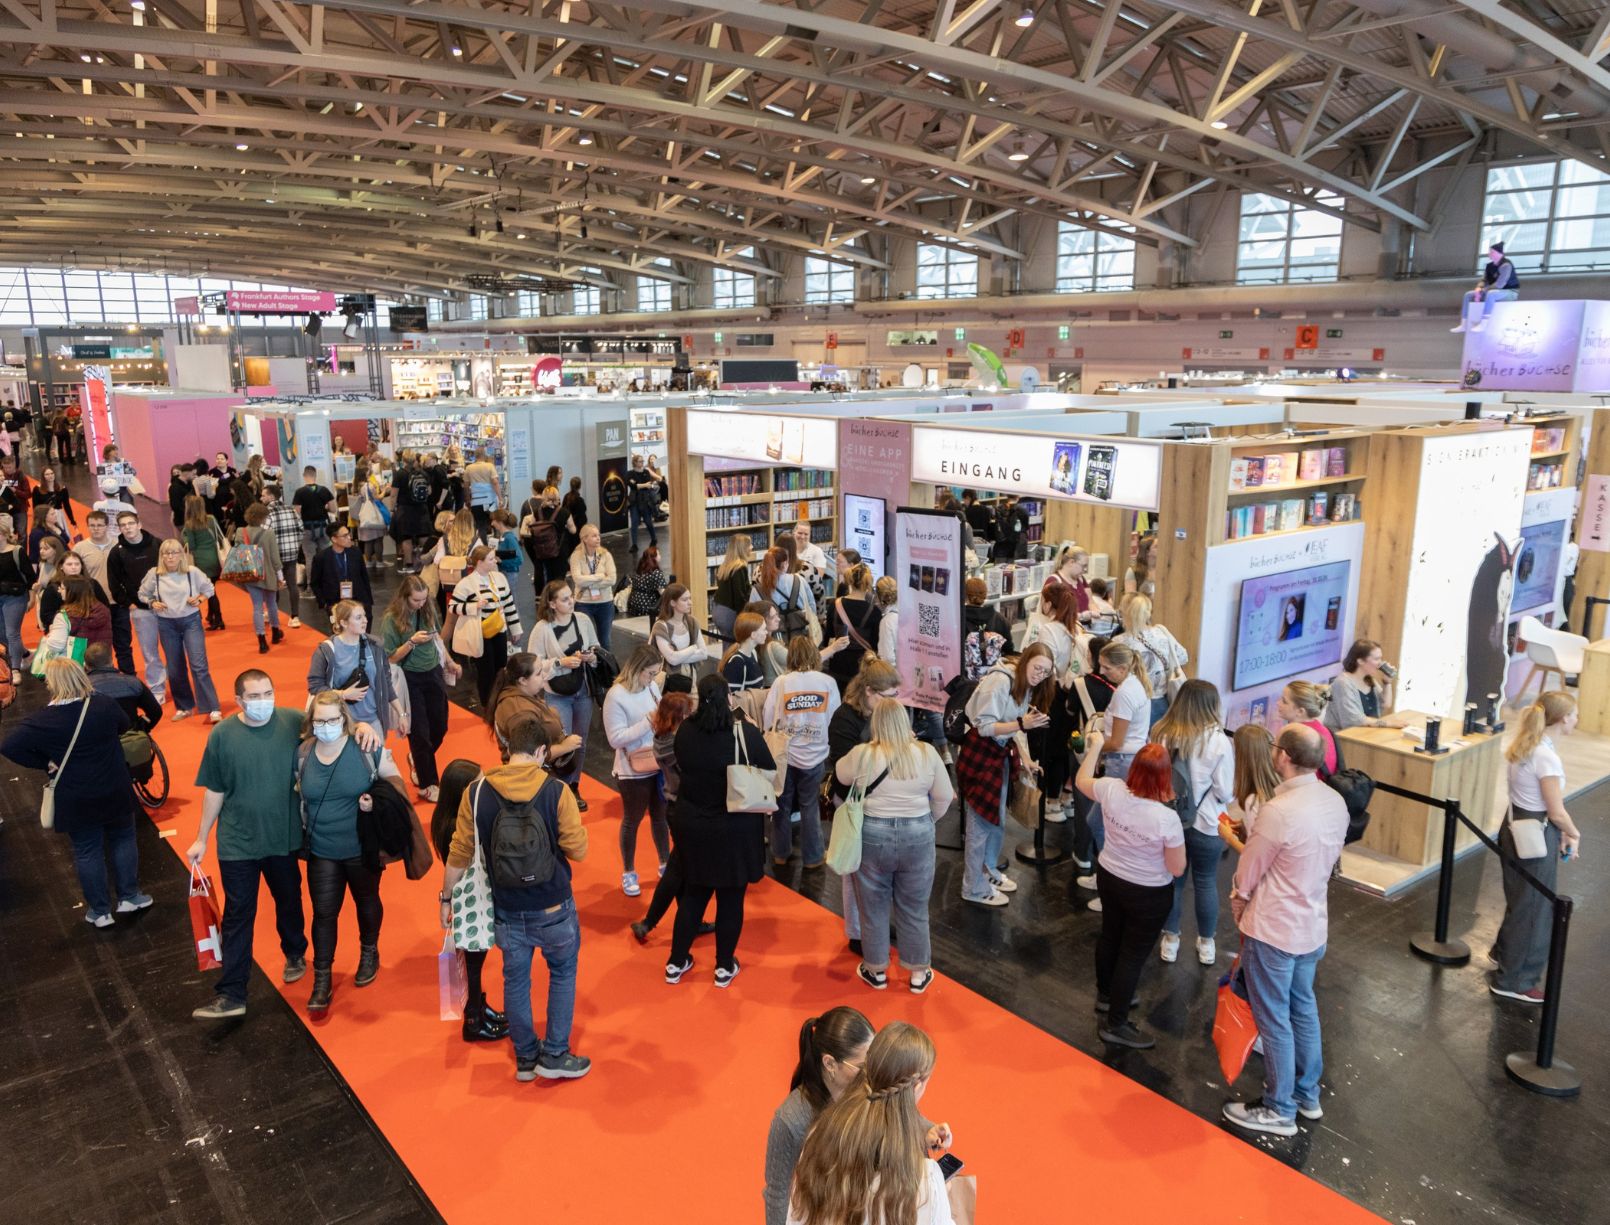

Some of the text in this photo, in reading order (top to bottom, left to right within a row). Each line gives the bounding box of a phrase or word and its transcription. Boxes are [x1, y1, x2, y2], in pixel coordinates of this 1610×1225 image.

[240, 292, 320, 302] Frankfurt Authors Stage
[241, 301, 298, 310] New Adult Stage
[1302, 328, 1313, 343] C
[605, 427, 619, 441] PAN
[848, 443, 902, 460] EINE APP
[941, 460, 1021, 482] EINGANG
[1593, 484, 1607, 531] KASSE
[786, 701, 823, 710] SUNDAY
[790, 694, 818, 703] GOOD
